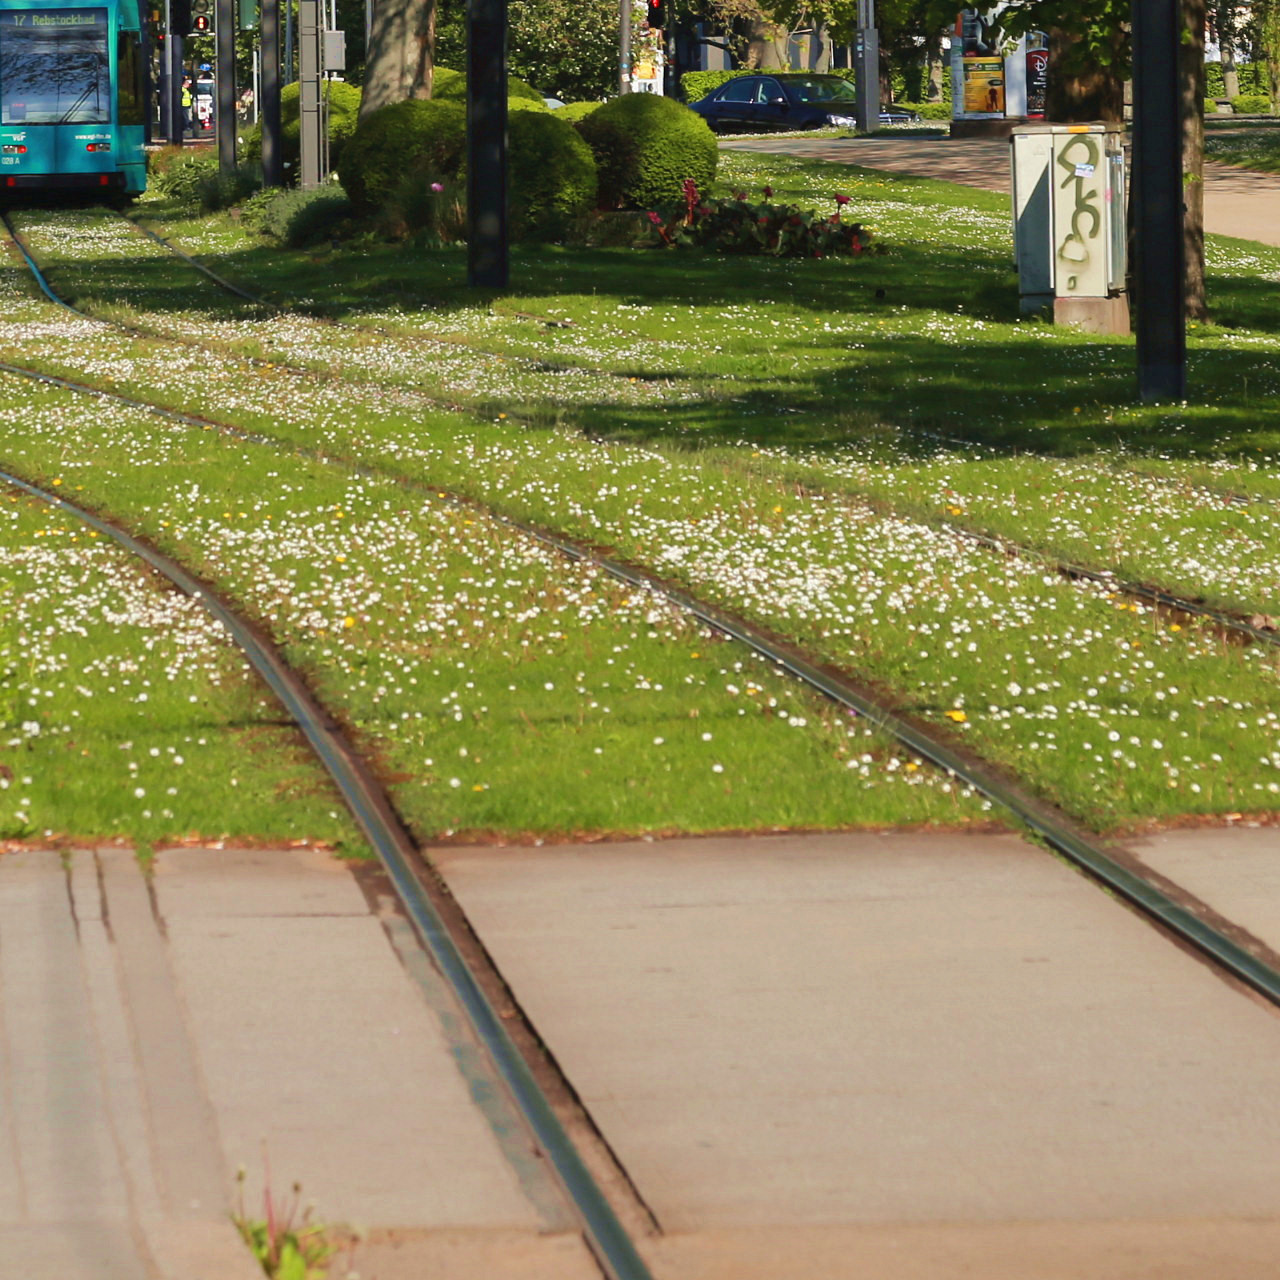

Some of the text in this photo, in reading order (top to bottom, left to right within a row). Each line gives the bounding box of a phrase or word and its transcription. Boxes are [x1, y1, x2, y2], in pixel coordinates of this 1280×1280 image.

[13, 13, 96, 27] 17 Rebstockbad
[15, 157, 20, 165] A
